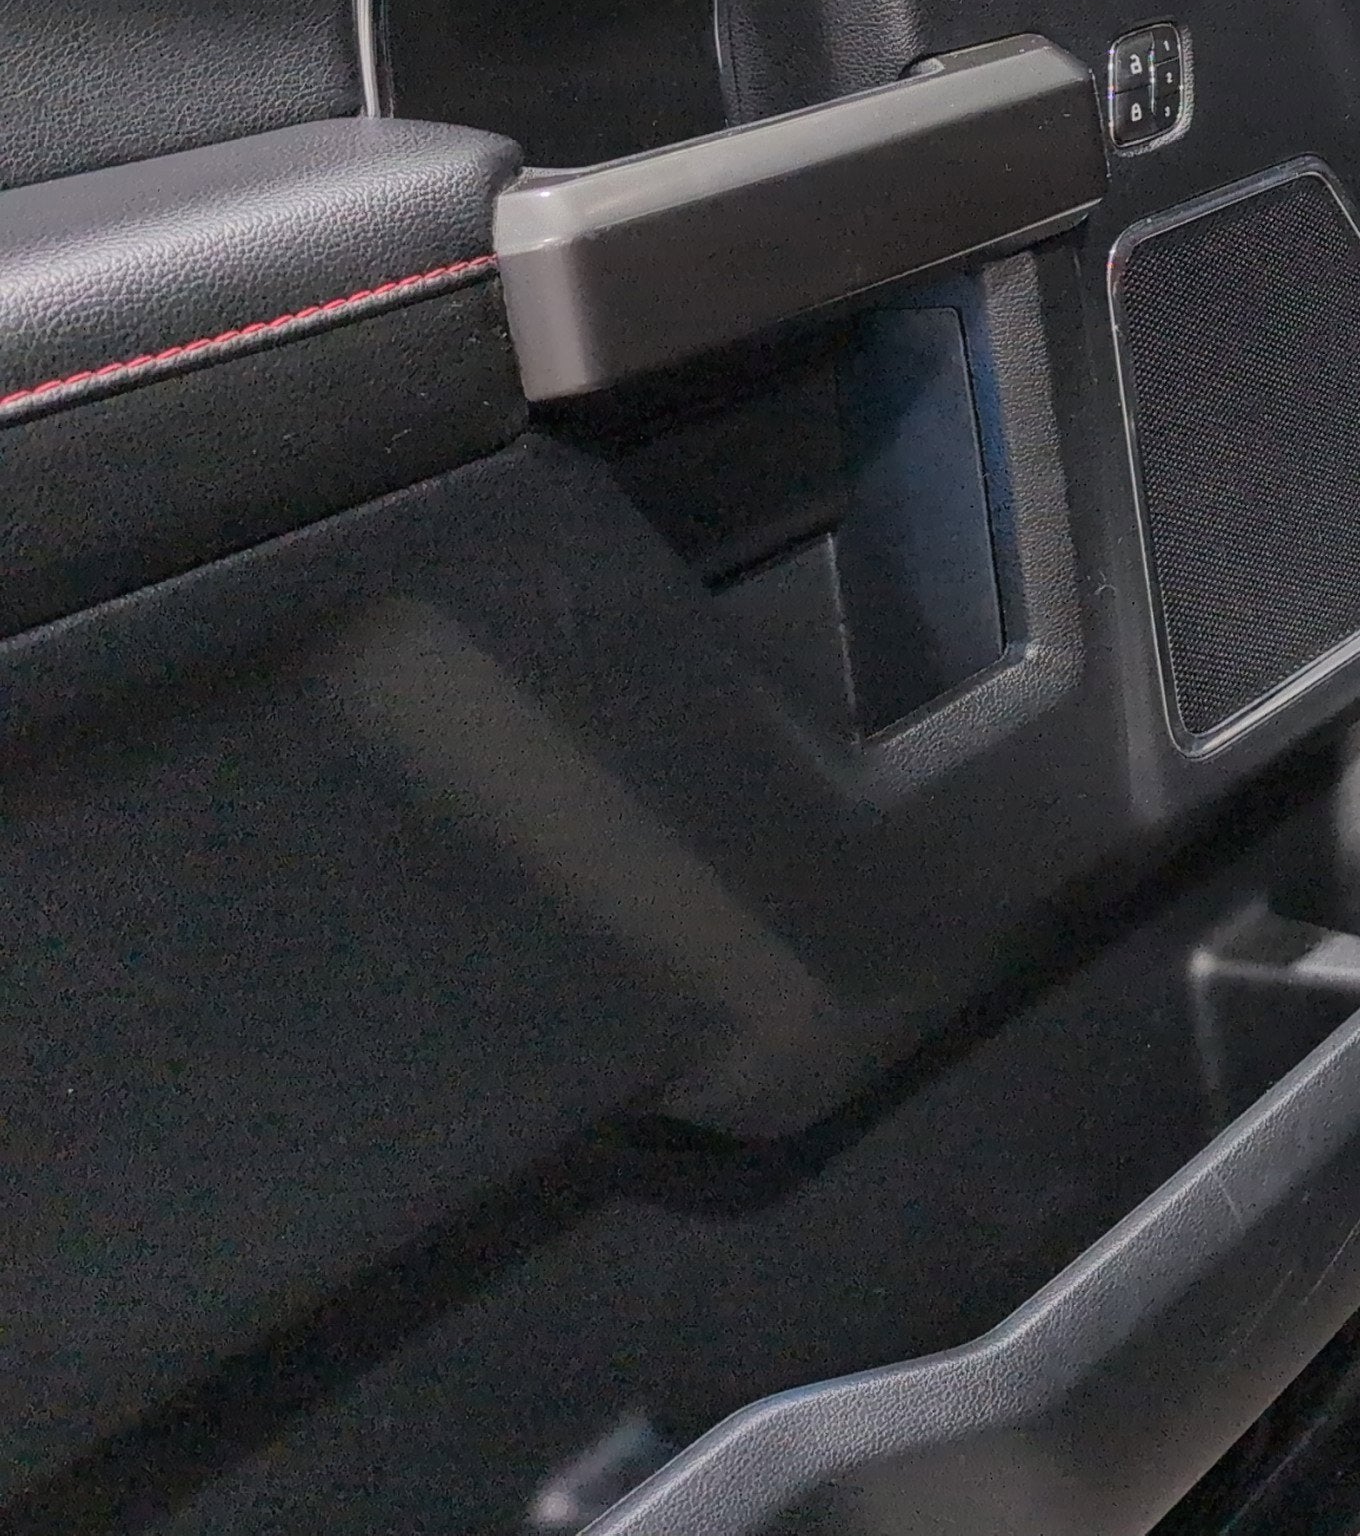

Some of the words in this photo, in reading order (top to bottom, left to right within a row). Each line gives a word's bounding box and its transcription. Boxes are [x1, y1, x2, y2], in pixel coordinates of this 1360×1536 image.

[1163, 40, 1170, 51] 1
[1165, 72, 1173, 84] 2
[1164, 106, 1171, 117] 3
